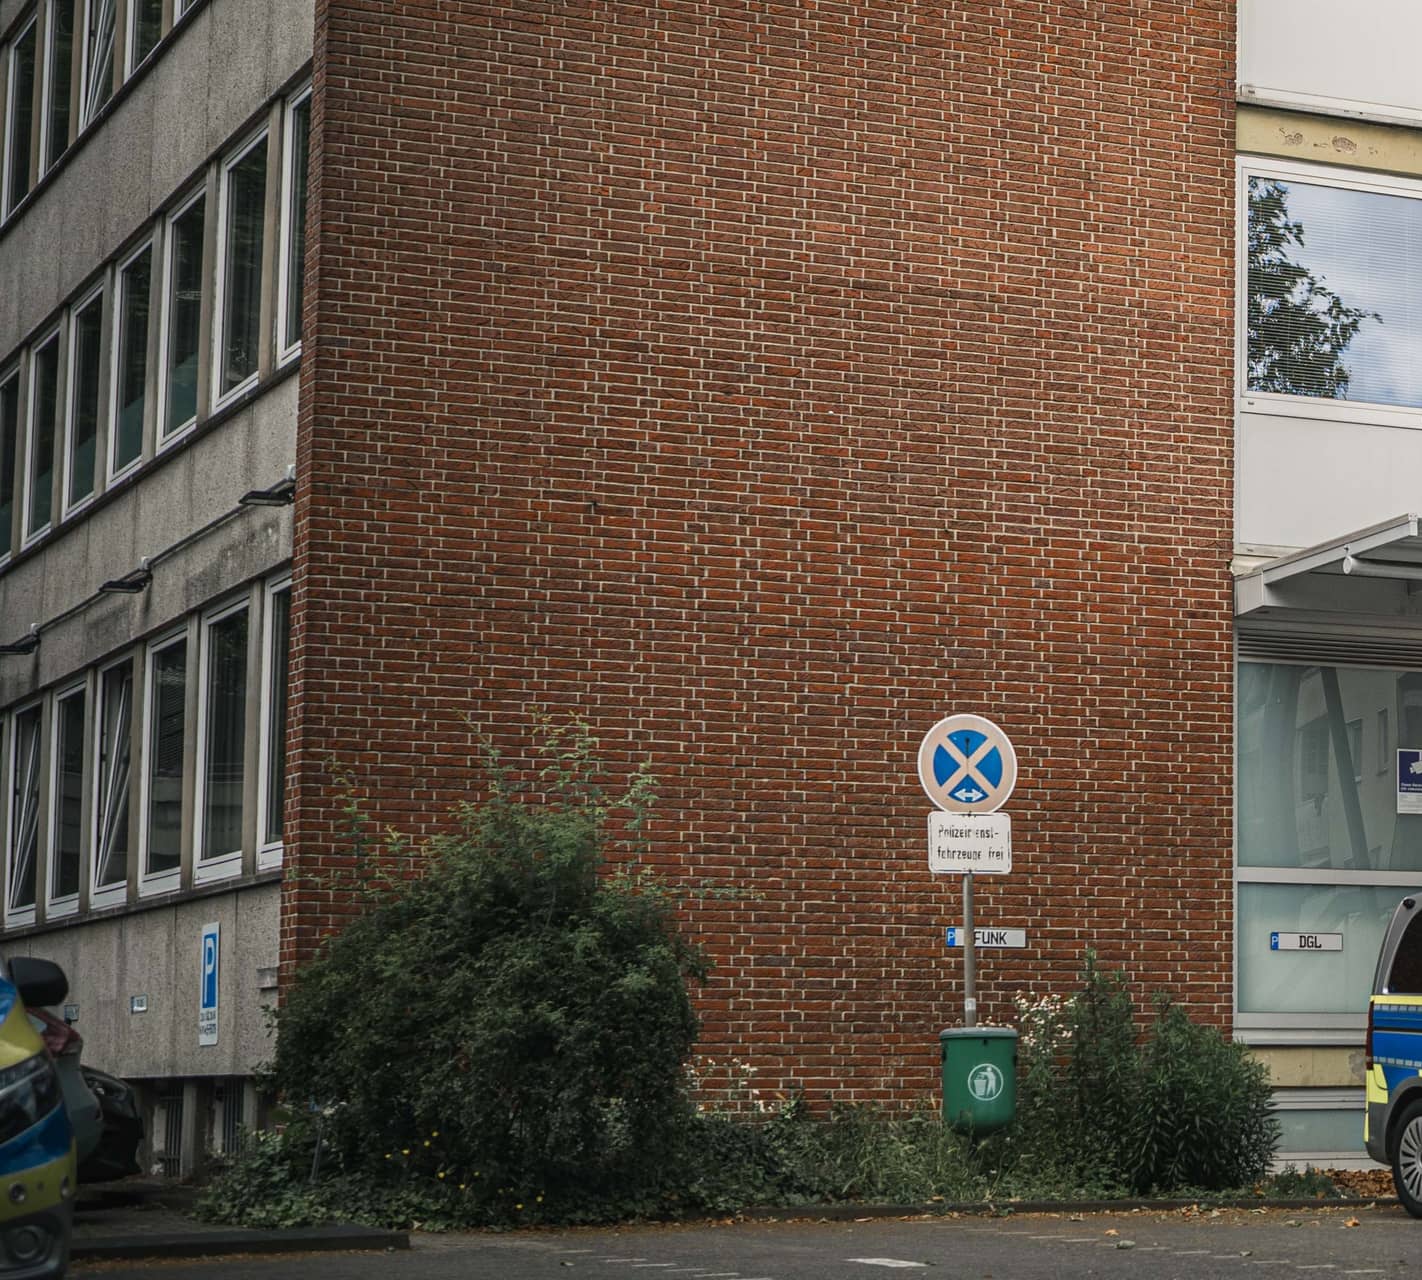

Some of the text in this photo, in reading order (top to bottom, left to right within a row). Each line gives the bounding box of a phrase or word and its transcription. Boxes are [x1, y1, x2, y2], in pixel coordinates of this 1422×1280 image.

[988, 846, 1004, 860] frei
[973, 931, 1008, 945] FUNK
[1299, 935, 1322, 948] DGL
